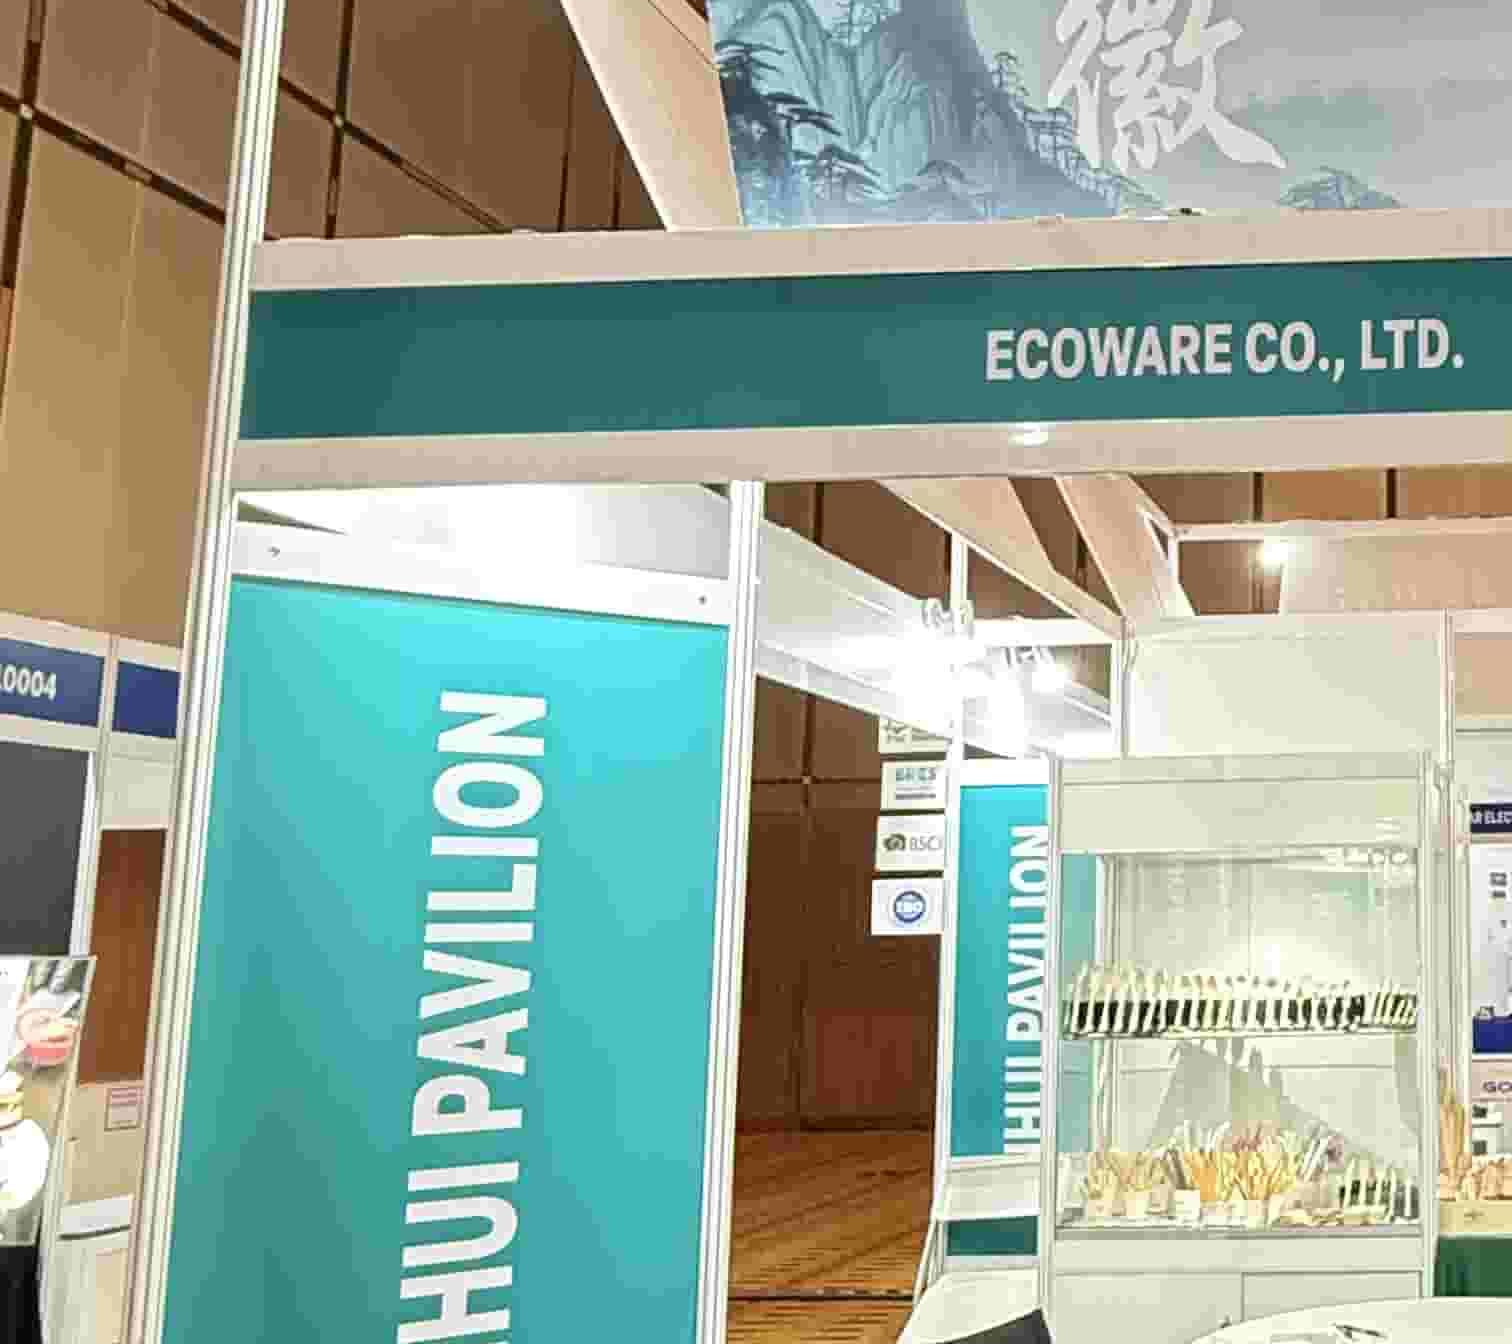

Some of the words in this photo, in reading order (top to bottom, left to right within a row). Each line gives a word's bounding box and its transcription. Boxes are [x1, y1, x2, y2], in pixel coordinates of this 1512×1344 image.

[985, 322, 1233, 381] ECOWARE
[1245, 320, 1345, 383] CO.,
[1359, 318, 1464, 371] LTD.
[0, 663, 56, 702] 0004
[411, 690, 548, 1137] PAVILION
[1006, 824, 1049, 1041] PAVILION
